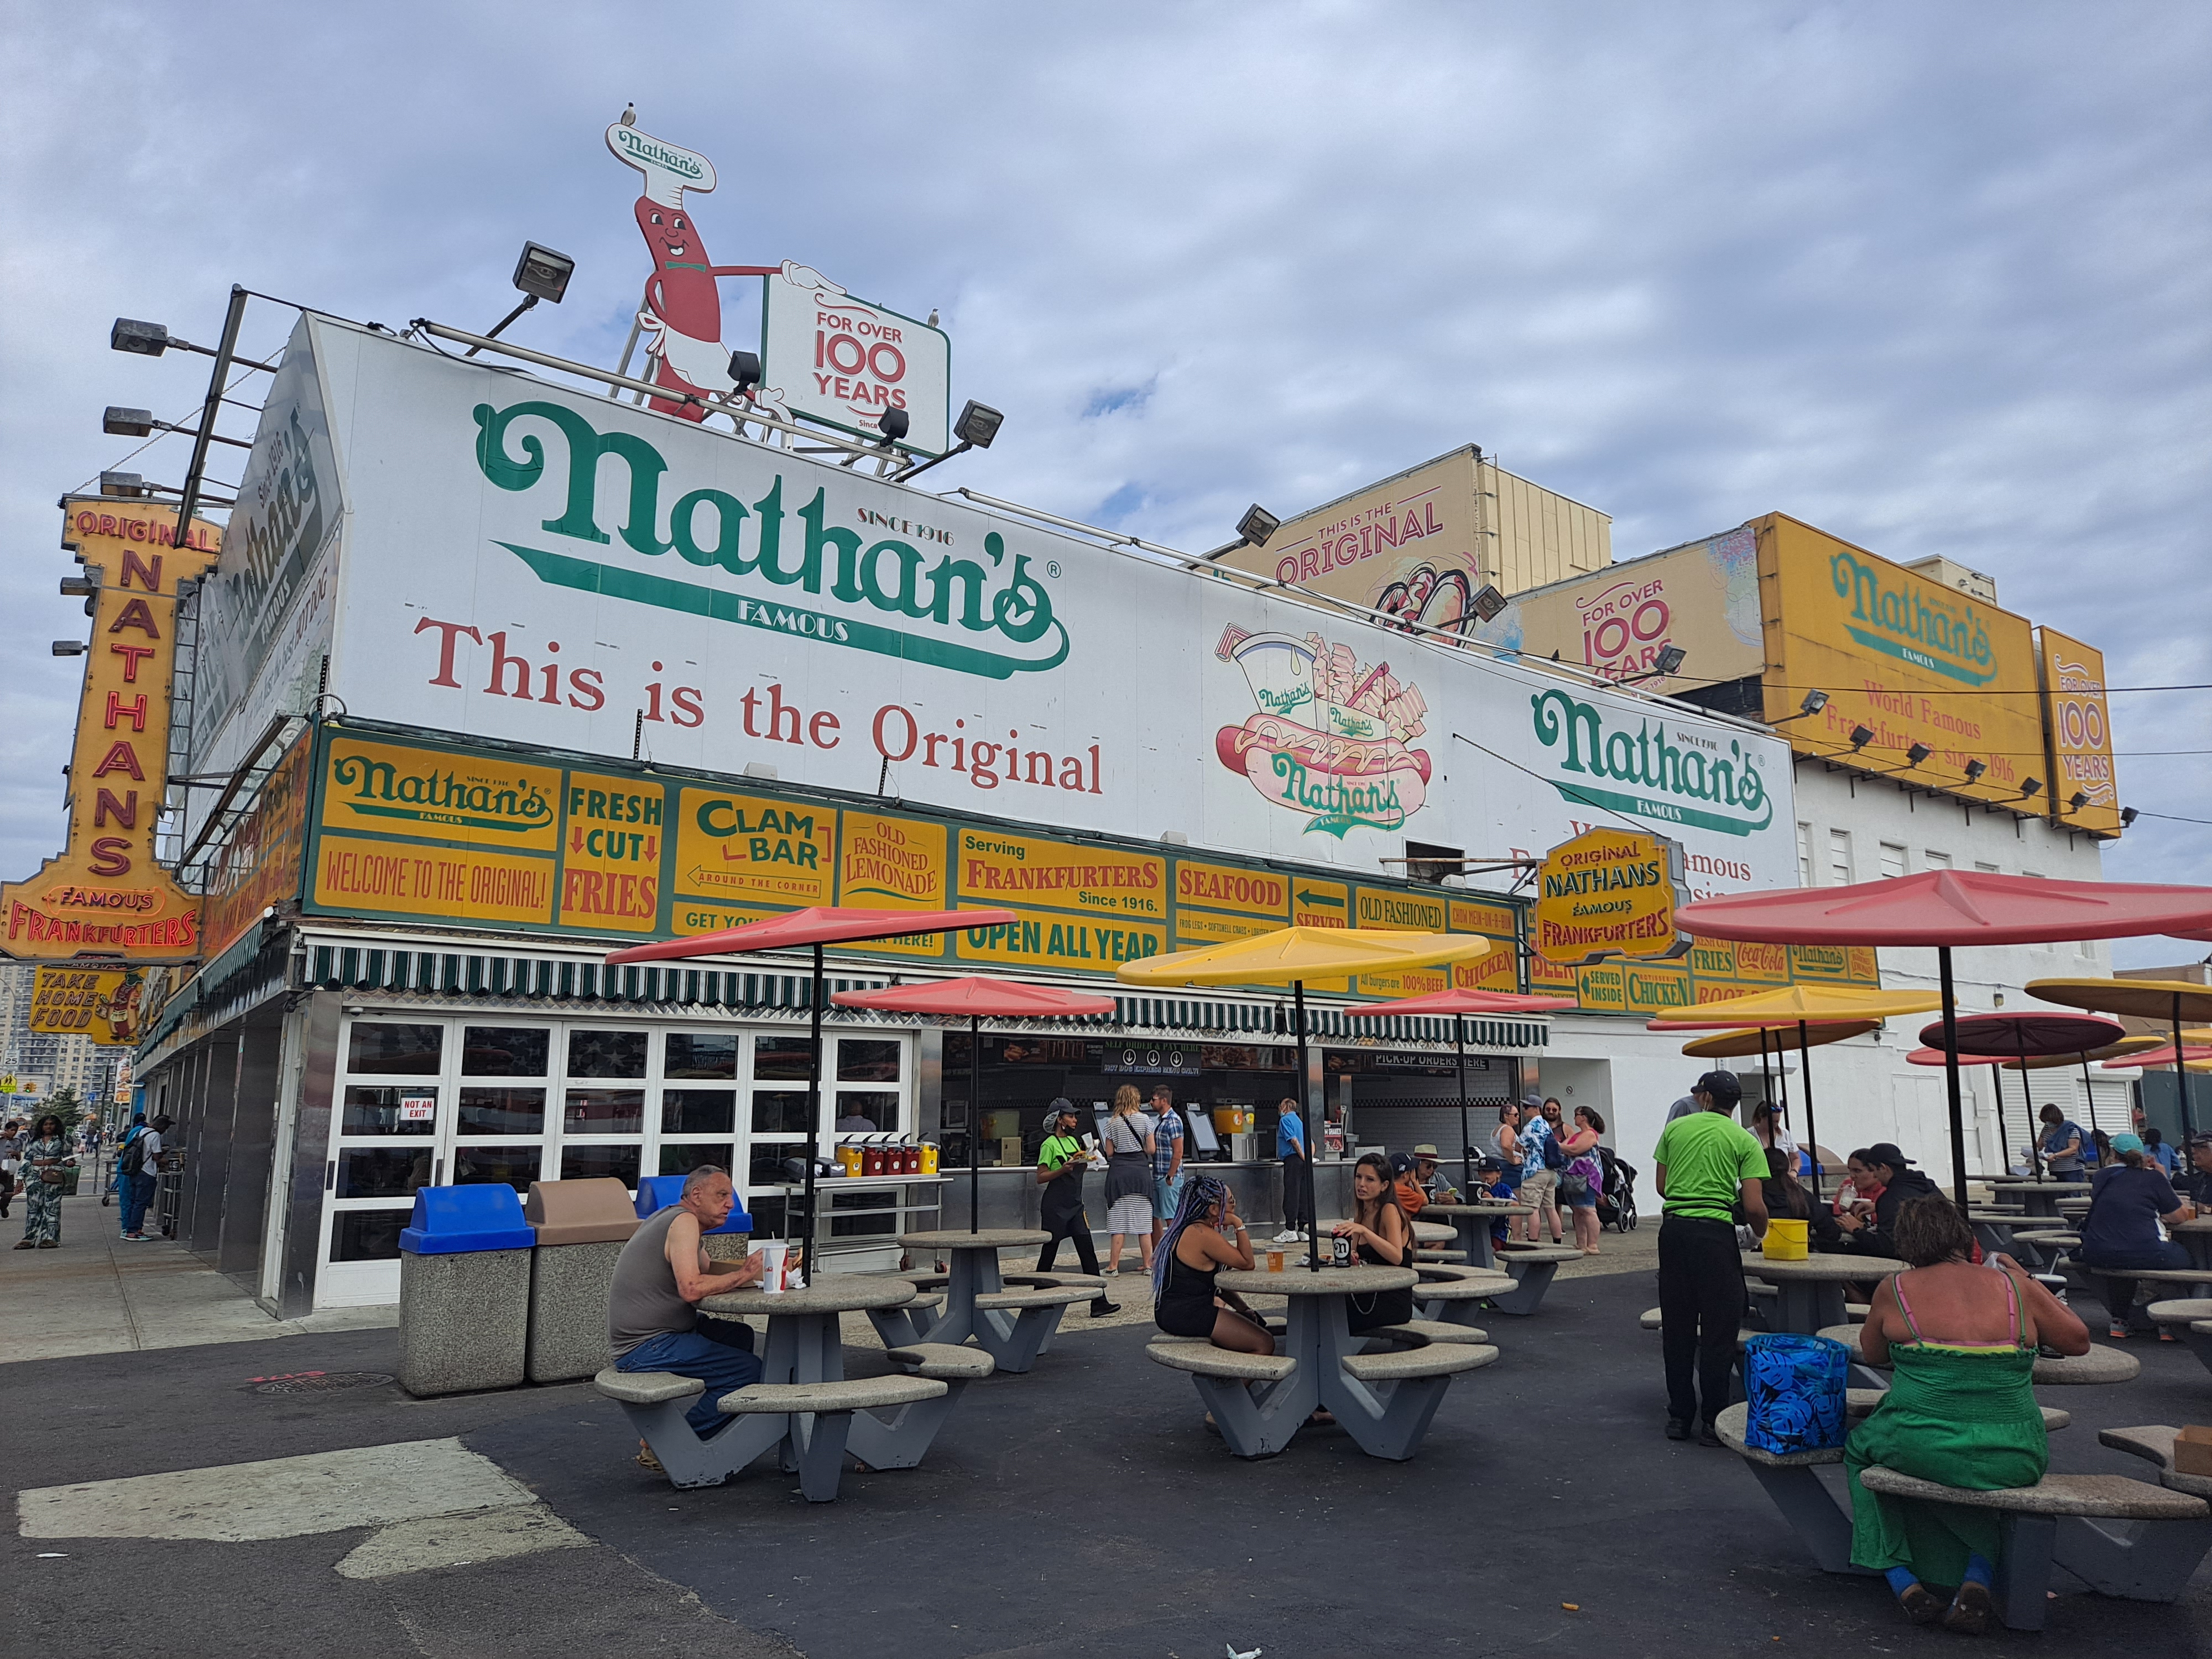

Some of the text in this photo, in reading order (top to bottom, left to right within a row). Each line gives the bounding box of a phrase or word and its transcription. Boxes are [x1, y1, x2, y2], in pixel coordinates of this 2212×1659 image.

[618, 130, 700, 175] Nathan's
[816, 311, 902, 343] FOR OVER
[814, 330, 906, 383] 100
[812, 372, 906, 410] YEARS
[859, 419, 878, 429] Since
[76, 510, 216, 552] ORIGINAL
[473, 401, 1059, 644] Nathan's
[857, 508, 954, 546] SINCE 1916
[1318, 501, 1392, 539] THIS IS THE
[1275, 501, 1444, 585] ORIGINAL
[1583, 578, 1663, 627] FOR OVER
[1829, 552, 1991, 666] Nathan's
[738, 599, 849, 642] FAMOUS
[1583, 599, 1670, 666] 100
[1902, 646, 1934, 669] FAMOUS
[1259, 682, 1311, 707] Nathan's
[1650, 677, 1666, 690] 1916
[2059, 676, 2103, 699] FOR OVER
[88, 549, 163, 876] NATHANS
[414, 616, 1103, 795] This is the Original
[1330, 707, 1372, 731] Nathan's
[1863, 679, 1981, 740] World Famous
[2057, 700, 2105, 750] 100
[1531, 689, 1763, 811] Nathan's
[1990, 753, 2015, 782] 1916
[2062, 754, 2110, 781] YEARS
[334, 755, 546, 817] Nathan's
[1271, 752, 1400, 816] Nathan's
[419, 812, 462, 825] FAMOUS
[570, 787, 662, 826] FRESH
[696, 800, 813, 839] CLAM
[1637, 800, 1682, 821] FAMOUS
[587, 830, 644, 860] CUT
[877, 822, 905, 846] OLD
[965, 836, 1025, 860] Serving
[749, 837, 818, 870] BAR
[854, 837, 928, 872] FASHIONED
[1560, 841, 1641, 869] ORIGINAL
[326, 851, 409, 897] WELCOME
[414, 859, 432, 900] TO
[439, 861, 467, 902] THE
[470, 864, 546, 909] ORIGINAL!
[698, 872, 818, 894] AROUND THE CORNER
[845, 853, 937, 896] LEMONADE
[967, 859, 1158, 891] FRANKFURTERS
[1180, 869, 1281, 906] SEAFOOD
[1545, 860, 1661, 898] NATHANS
[61, 889, 153, 910] FAMOUS
[561, 867, 656, 918] FRIES
[1079, 891, 1158, 912] Since 1916.
[1572, 900, 1632, 917] FAMOUS
[8, 900, 197, 946] FRANKFURTERS
[686, 912, 717, 928] GET
[1180, 919, 1191, 928] FROG
[1192, 921, 1203, 930] LEGS
[1208, 922, 1232, 933] SOFTSHELL
[1233, 925, 1246, 935] CRABS
[1297, 912, 1345, 928] SERVED
[1360, 896, 1442, 928] OLD FASHIONED
[1453, 907, 1468, 924] CHOW
[1469, 910, 1512, 931] MEIN-ON-A-BUN
[1543, 907, 1668, 948] FRANKFURTERS
[967, 920, 1157, 962] OPEN ALL YEAR
[1455, 951, 1513, 988] CHICKEN
[1693, 949, 1733, 972] FRIES
[42, 972, 100, 989] TAKE
[1369, 974, 1390, 990] burgers
[1391, 980, 1400, 989] are
[1402, 974, 1425, 992] 100%
[1426, 977, 1444, 992] BEEF
[1590, 971, 1621, 985] SERVED
[1591, 986, 1623, 1002] INSIDE
[1629, 973, 1688, 1006] CHICKEN
[1640, 974, 1677, 982] ROTISSERIE
[36, 990, 98, 1006] HOME
[32, 1008, 92, 1027] FOOD
[1126, 1041, 1152, 1050] ORDER
[1181, 1044, 1200, 1052] HERE
[1376, 1054, 1415, 1065] PICK-UP
[1418, 1056, 1457, 1066] ORDERS
[404, 1100, 432, 1109] NOT AN
[410, 1109, 426, 1118] EXIT
